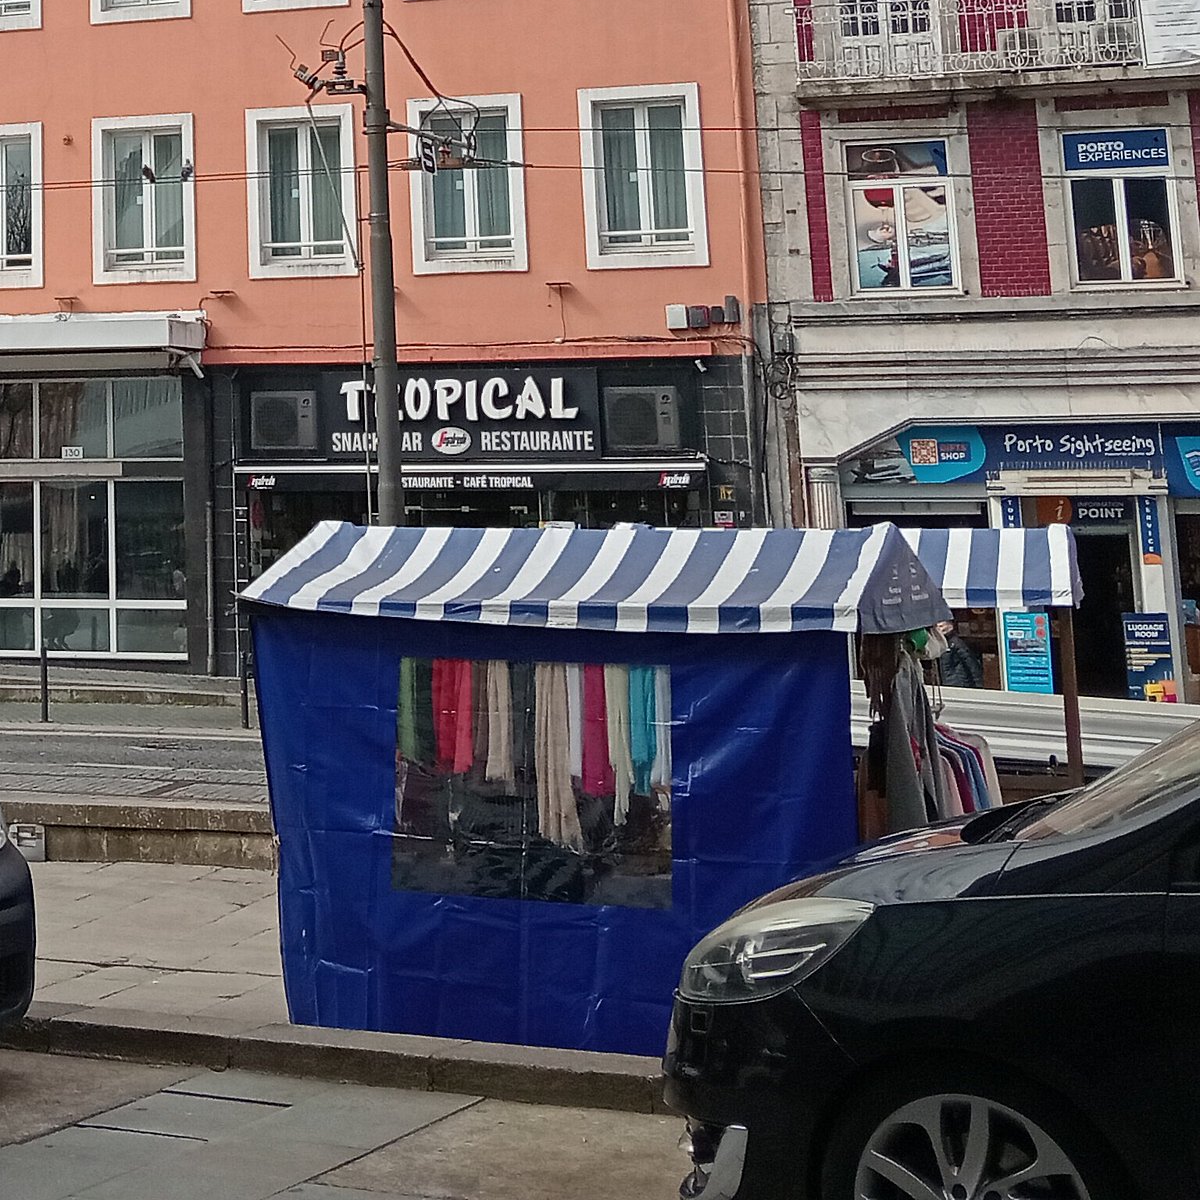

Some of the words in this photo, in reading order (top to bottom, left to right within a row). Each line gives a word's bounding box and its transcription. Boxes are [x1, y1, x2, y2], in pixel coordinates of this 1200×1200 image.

[1077, 141, 1124, 153] PORTO
[1078, 148, 1167, 163] EXPERIENCES
[339, 377, 579, 421] TOPICAL
[401, 431, 423, 452] AR
[481, 431, 595, 452] RESTAURANTE
[1004, 433, 1054, 453] Porto
[1059, 434, 1155, 458] Sightseeing
[64, 448, 80, 457] 130
[940, 452, 966, 461] SHOP
[400, 476, 455, 489] STAURANTE
[463, 474, 487, 489] CAFÉ
[488, 476, 534, 489] TROPICAL
[1077, 508, 1124, 519] POINT
[1127, 623, 1164, 631] LUGGAGE
